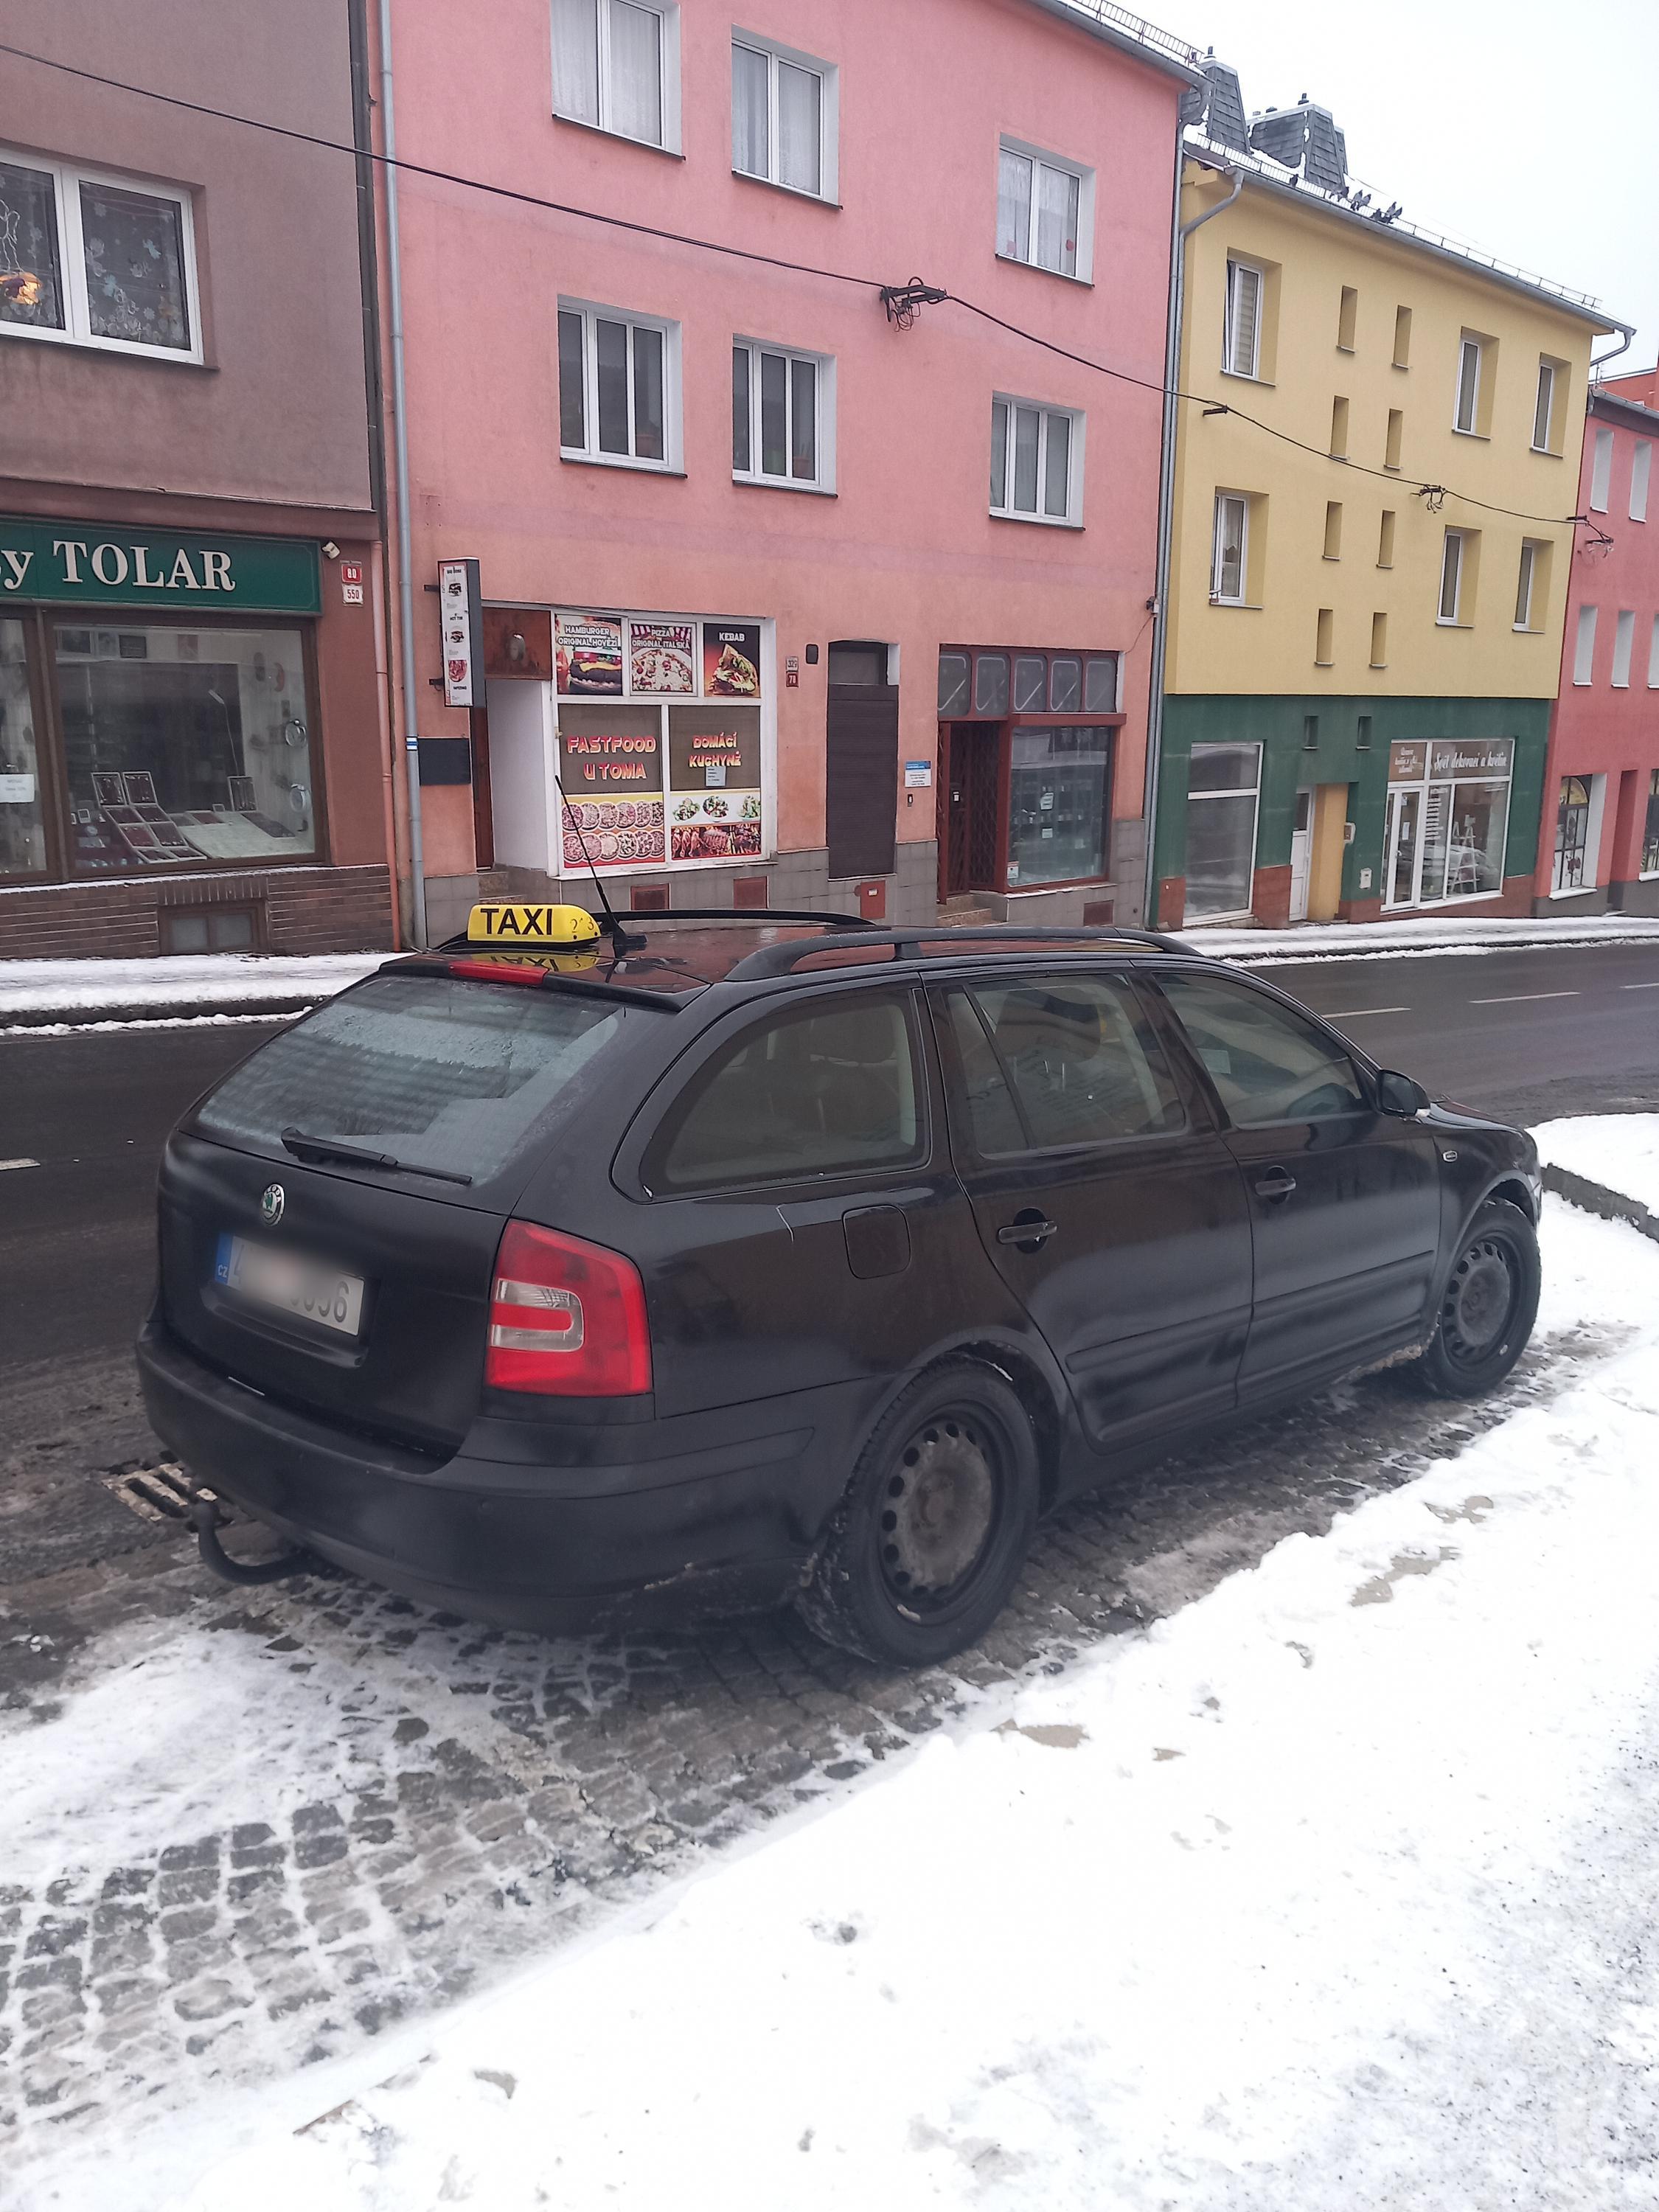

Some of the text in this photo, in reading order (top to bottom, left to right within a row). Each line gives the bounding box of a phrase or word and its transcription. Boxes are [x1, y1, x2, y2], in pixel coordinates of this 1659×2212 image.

[0, 540, 236, 591] y TOLAR
[347, 567, 357, 579] 80
[347, 589, 360, 599] 550
[565, 625, 611, 636] HAMBURGER
[651, 629, 671, 638] PIZZA
[558, 636, 619, 647] ORIGINAL HOVĚZÍ
[718, 632, 745, 642] KEBAB
[632, 639, 690, 649] ORIGINAL ITALSKÁ
[566, 735, 657, 754] FASTFOOD
[692, 731, 738, 749] DOMÁCÍ
[1480, 757, 1486, 768] a
[583, 762, 647, 781] U TOMA
[480, 908, 554, 936] TAXI
[218, 1264, 228, 1279] CZ
